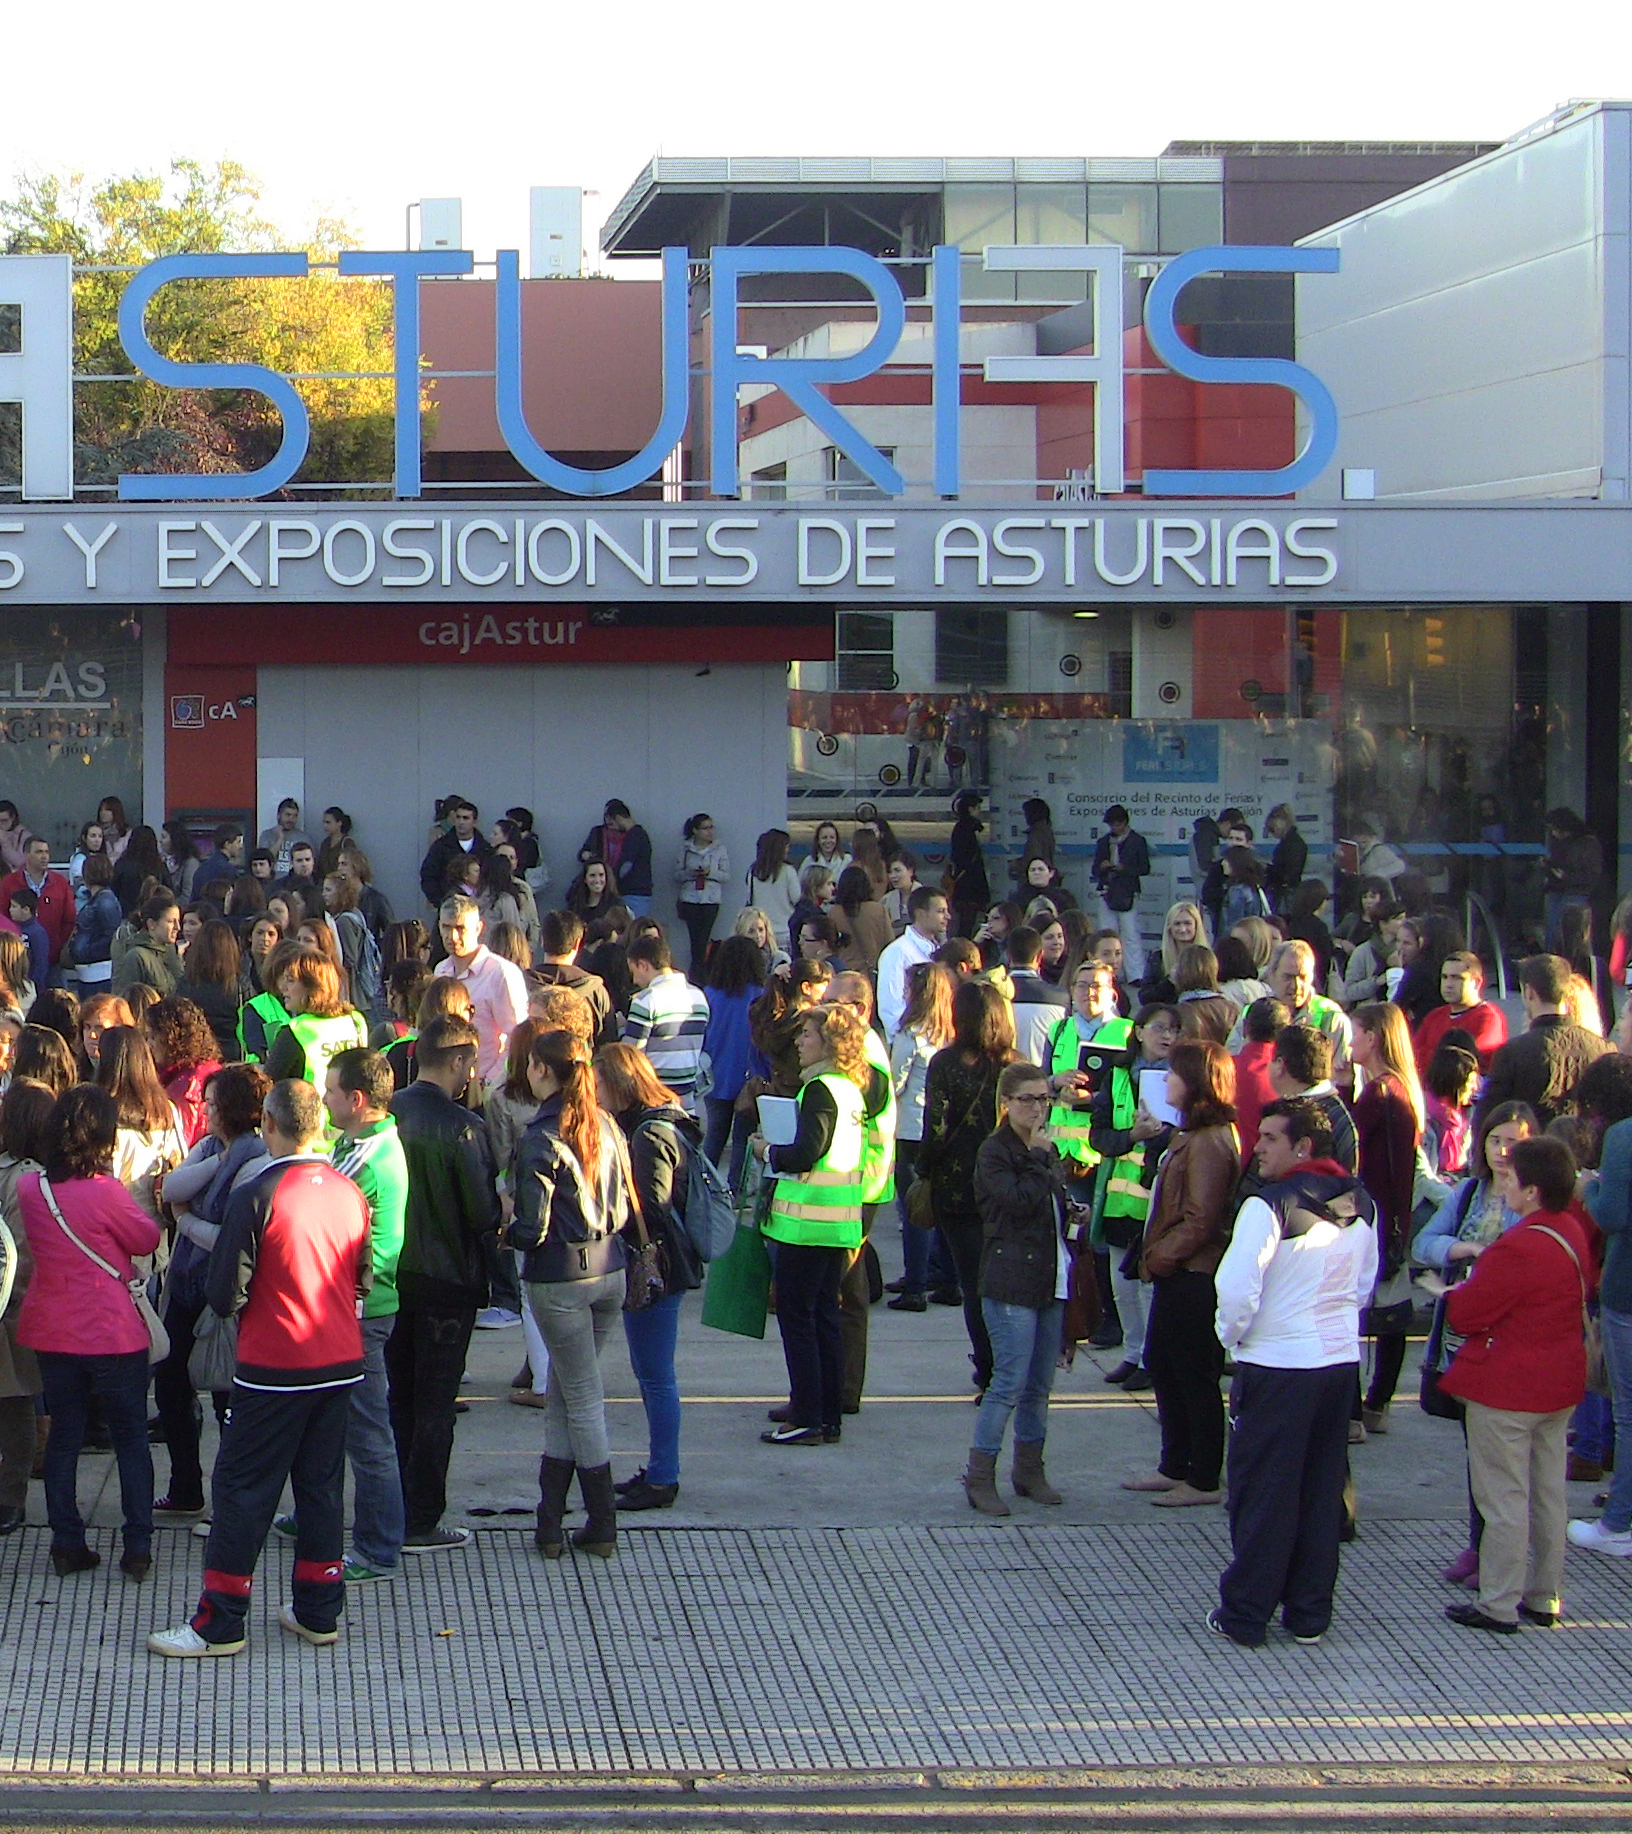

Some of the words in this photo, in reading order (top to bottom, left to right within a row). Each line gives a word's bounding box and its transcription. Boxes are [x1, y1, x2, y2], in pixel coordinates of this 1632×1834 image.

[62, 521, 119, 590] Y
[157, 517, 760, 589] EXPOSICIONES
[798, 518, 896, 587] DE
[934, 517, 1339, 588] ASTURIAS
[418, 614, 583, 655] cajAstur
[208, 701, 238, 720] cA
[1066, 792, 1127, 803] Consorcio
[1131, 792, 1150, 803] del
[1154, 793, 1202, 803] Recinto
[1204, 792, 1220, 803] de
[1224, 792, 1254, 803] Ferias
[1151, 806, 1166, 817] de
[1171, 806, 1216, 817] Asturias
